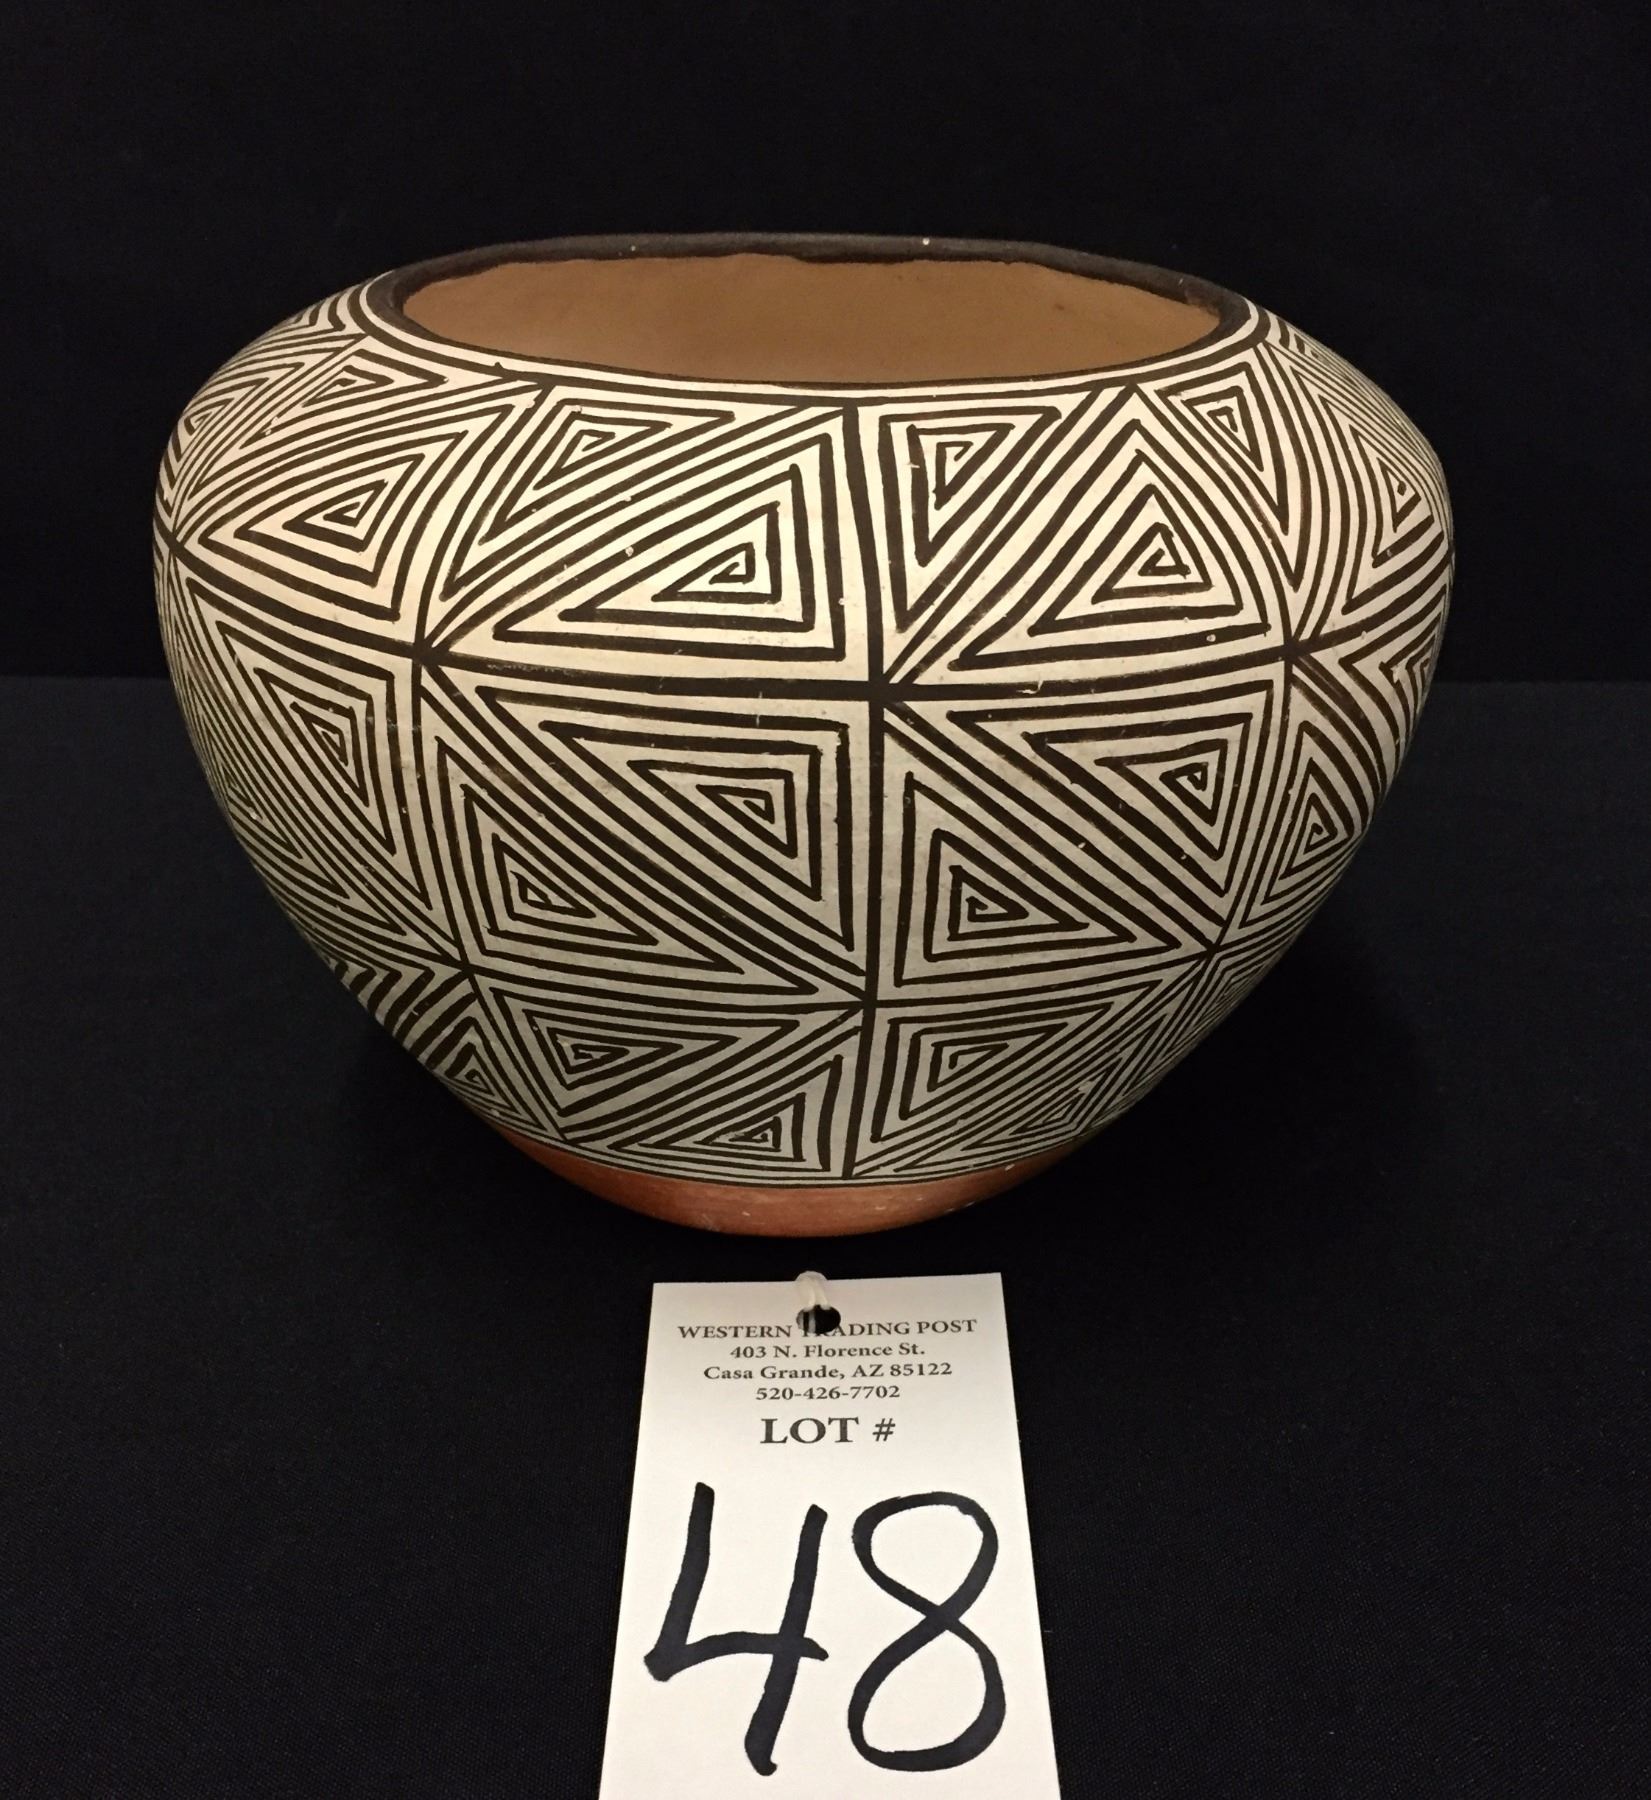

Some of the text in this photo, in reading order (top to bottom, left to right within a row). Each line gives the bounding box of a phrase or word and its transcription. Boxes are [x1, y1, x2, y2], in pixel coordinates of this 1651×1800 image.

[678, 1319, 978, 1339] WESTERN ADING POST
[730, 1342, 926, 1359] 403 N. Florence St.
[704, 1362, 953, 1380] Casa Grande, AZ 85122
[755, 1385, 901, 1400] 520-426-7702
[760, 1417, 896, 1444] LOT #
[643, 1481, 1007, 1777] 48
